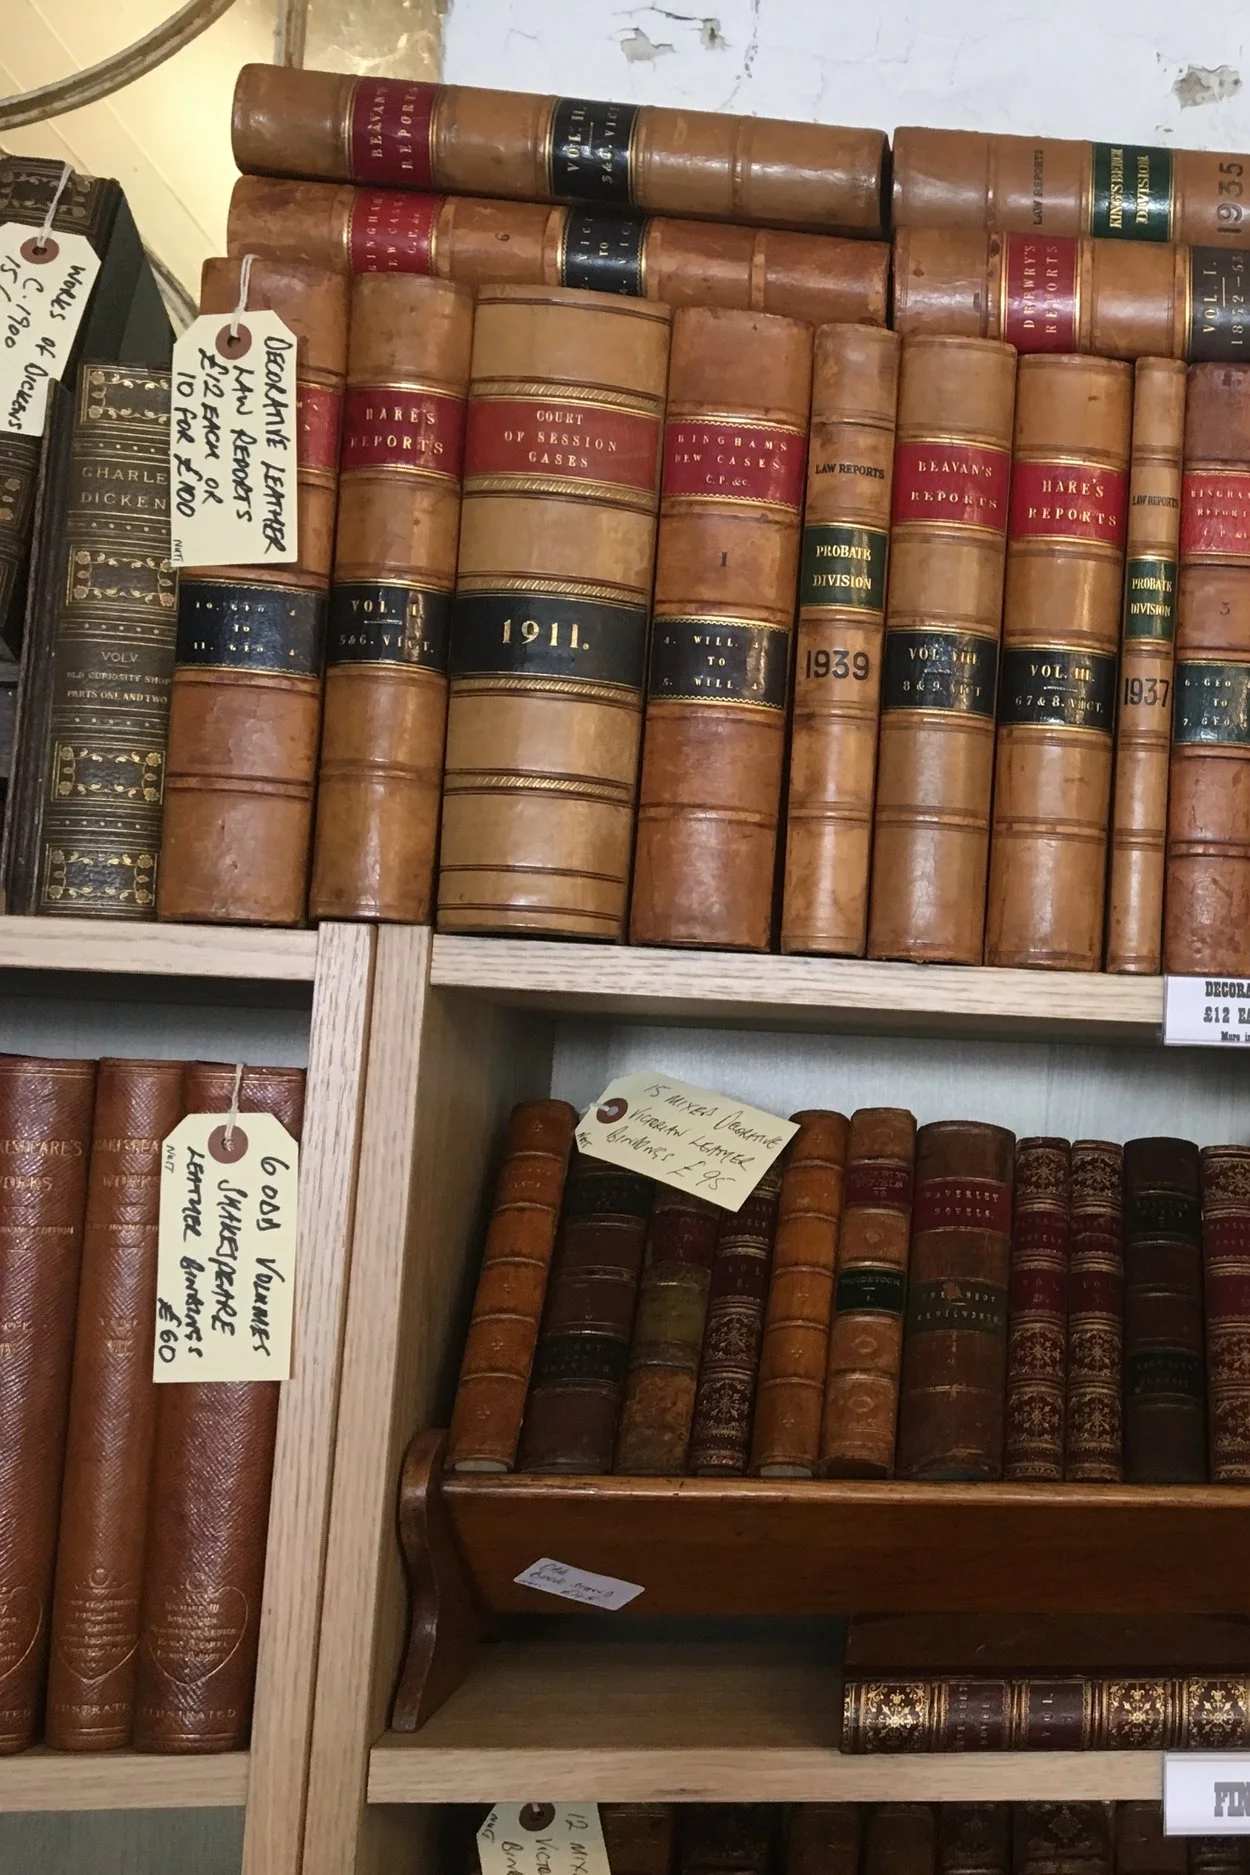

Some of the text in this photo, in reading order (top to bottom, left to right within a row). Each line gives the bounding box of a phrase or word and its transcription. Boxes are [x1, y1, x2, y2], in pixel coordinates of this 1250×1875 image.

[1033, 151, 1044, 225] LAW REPORTS
[1136, 155, 1150, 224] DIVISION
[1217, 162, 1243, 233] 1935
[1024, 245, 1036, 329] DREWRY'S
[1046, 245, 1058, 334] REPORTS
[199, 348, 229, 505] £12 EACH OR
[535, 410, 585, 425] COURT
[174, 372, 203, 518] 10 FOR £100
[231, 365, 257, 523] LAW REPORTS
[261, 335, 294, 555] DECORATIVE LEATHER
[504, 430, 618, 452] OF SESSION
[528, 450, 589, 469] CASES
[675, 453, 781, 471] NEW CASES
[917, 461, 993, 478] BEAVAN'S
[815, 463, 886, 480] LAW REPORTS
[1041, 479, 1105, 499] HARE'S
[911, 491, 998, 510] REPORTS
[1028, 507, 1117, 527] REPORTS
[816, 545, 873, 562] PROBATE
[812, 574, 873, 591] DIVISION
[1131, 577, 1173, 592] PROBATE
[1130, 603, 1171, 617] DIVISION
[502, 618, 590, 650] 1911.
[707, 656, 727, 668] TO
[805, 650, 870, 681] 1939
[1030, 664, 1069, 679] VOL.
[903, 681, 926, 692] 8 &
[1124, 677, 1170, 707] 1937
[67, 690, 98, 700] PARTS
[123, 693, 144, 702] AND
[145, 694, 168, 704] TWO
[1213, 698, 1228, 708] TO
[1203, 1006, 1230, 1023] £12
[1220, 1031, 1241, 1043] More
[644, 1083, 784, 1150] 15 MIXED DECORATIVE
[628, 1106, 755, 1173] VICTORIAN LEATHER
[181, 1146, 206, 1243] LEATHER
[250, 1156, 290, 1357] 6 ODD VOLUMES
[157, 1298, 182, 1363] £60
